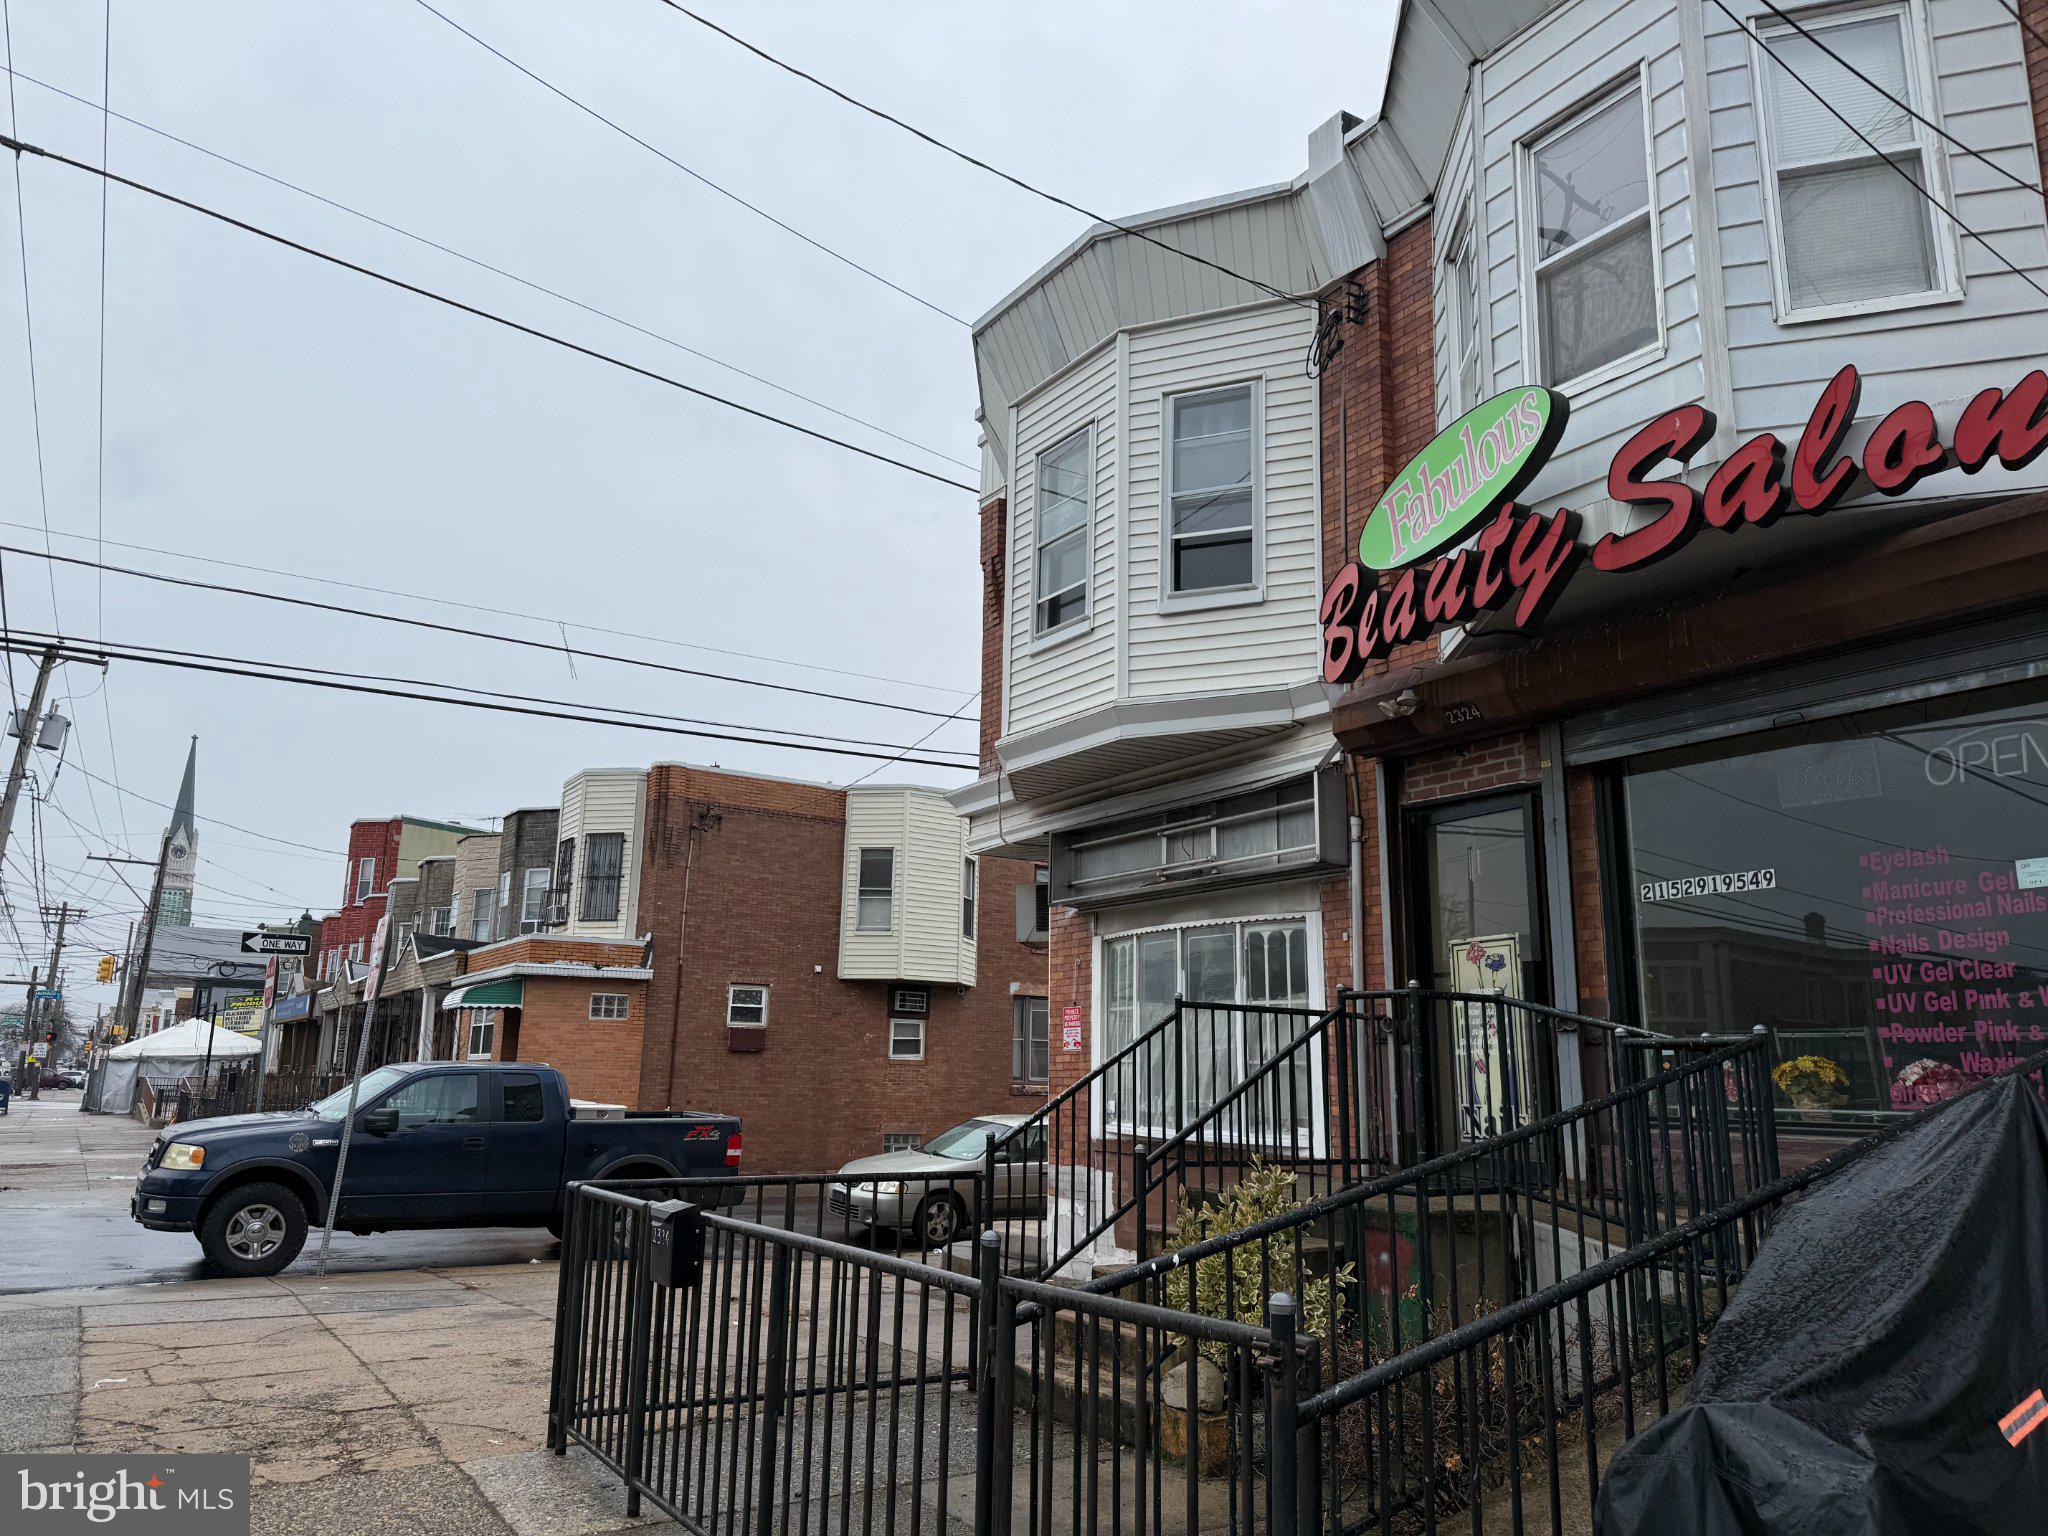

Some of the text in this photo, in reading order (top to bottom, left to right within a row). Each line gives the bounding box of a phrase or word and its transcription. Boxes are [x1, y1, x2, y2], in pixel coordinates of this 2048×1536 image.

[1382, 391, 1542, 562] Fabulous
[1320, 364, 2048, 683] Beauty Salon
[1445, 705, 1481, 724] 2324
[1925, 733, 2048, 786] OPEN
[1870, 846, 1949, 874] Eyelash
[1642, 870, 1774, 901] 2152919549
[1872, 869, 2016, 902] Manicure Gel
[1877, 892, 2047, 926] Professional Nails
[262, 940, 304, 950] ONE WAY
[1880, 927, 2010, 955] Nails Design
[1884, 959, 2016, 984] UV Gel Clear
[1887, 992, 1916, 1013] UV
[1924, 990, 1958, 1012] Gel
[1965, 988, 2011, 1010] Pink
[2019, 991, 2035, 1008] &
[1890, 1020, 2048, 1044] Powder Pink &
